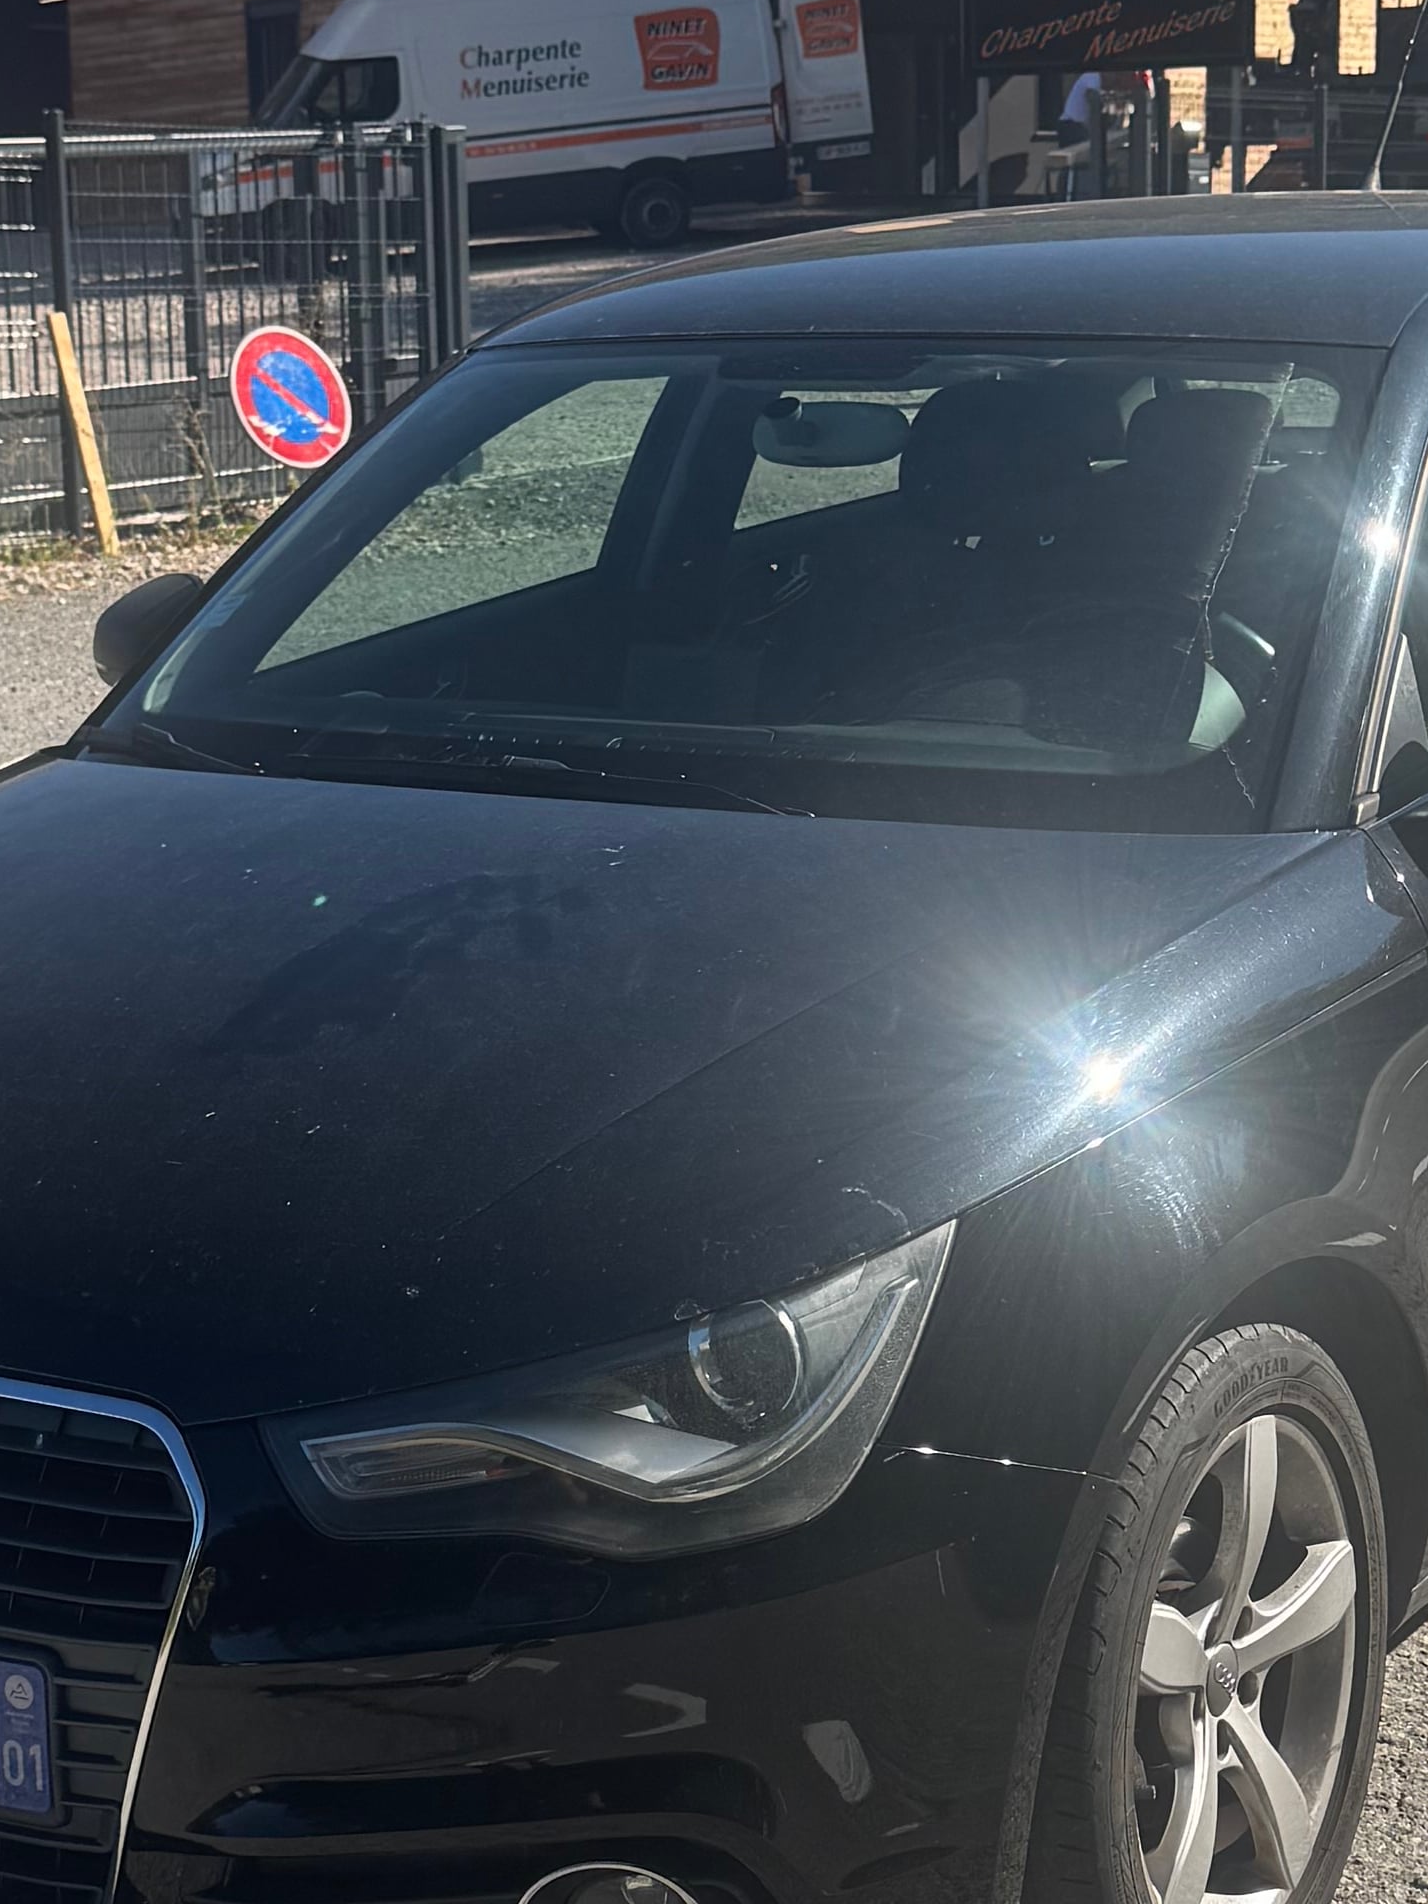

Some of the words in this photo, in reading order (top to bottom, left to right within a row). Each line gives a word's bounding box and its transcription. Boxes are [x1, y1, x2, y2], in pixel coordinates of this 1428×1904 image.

[647, 17, 706, 38] NINET
[980, 0, 1122, 58] Charpente
[460, 39, 582, 71] Charpente
[460, 66, 590, 100] Menuiserie
[652, 63, 710, 83] GAVIN
[2, 1739, 44, 1793] 01
